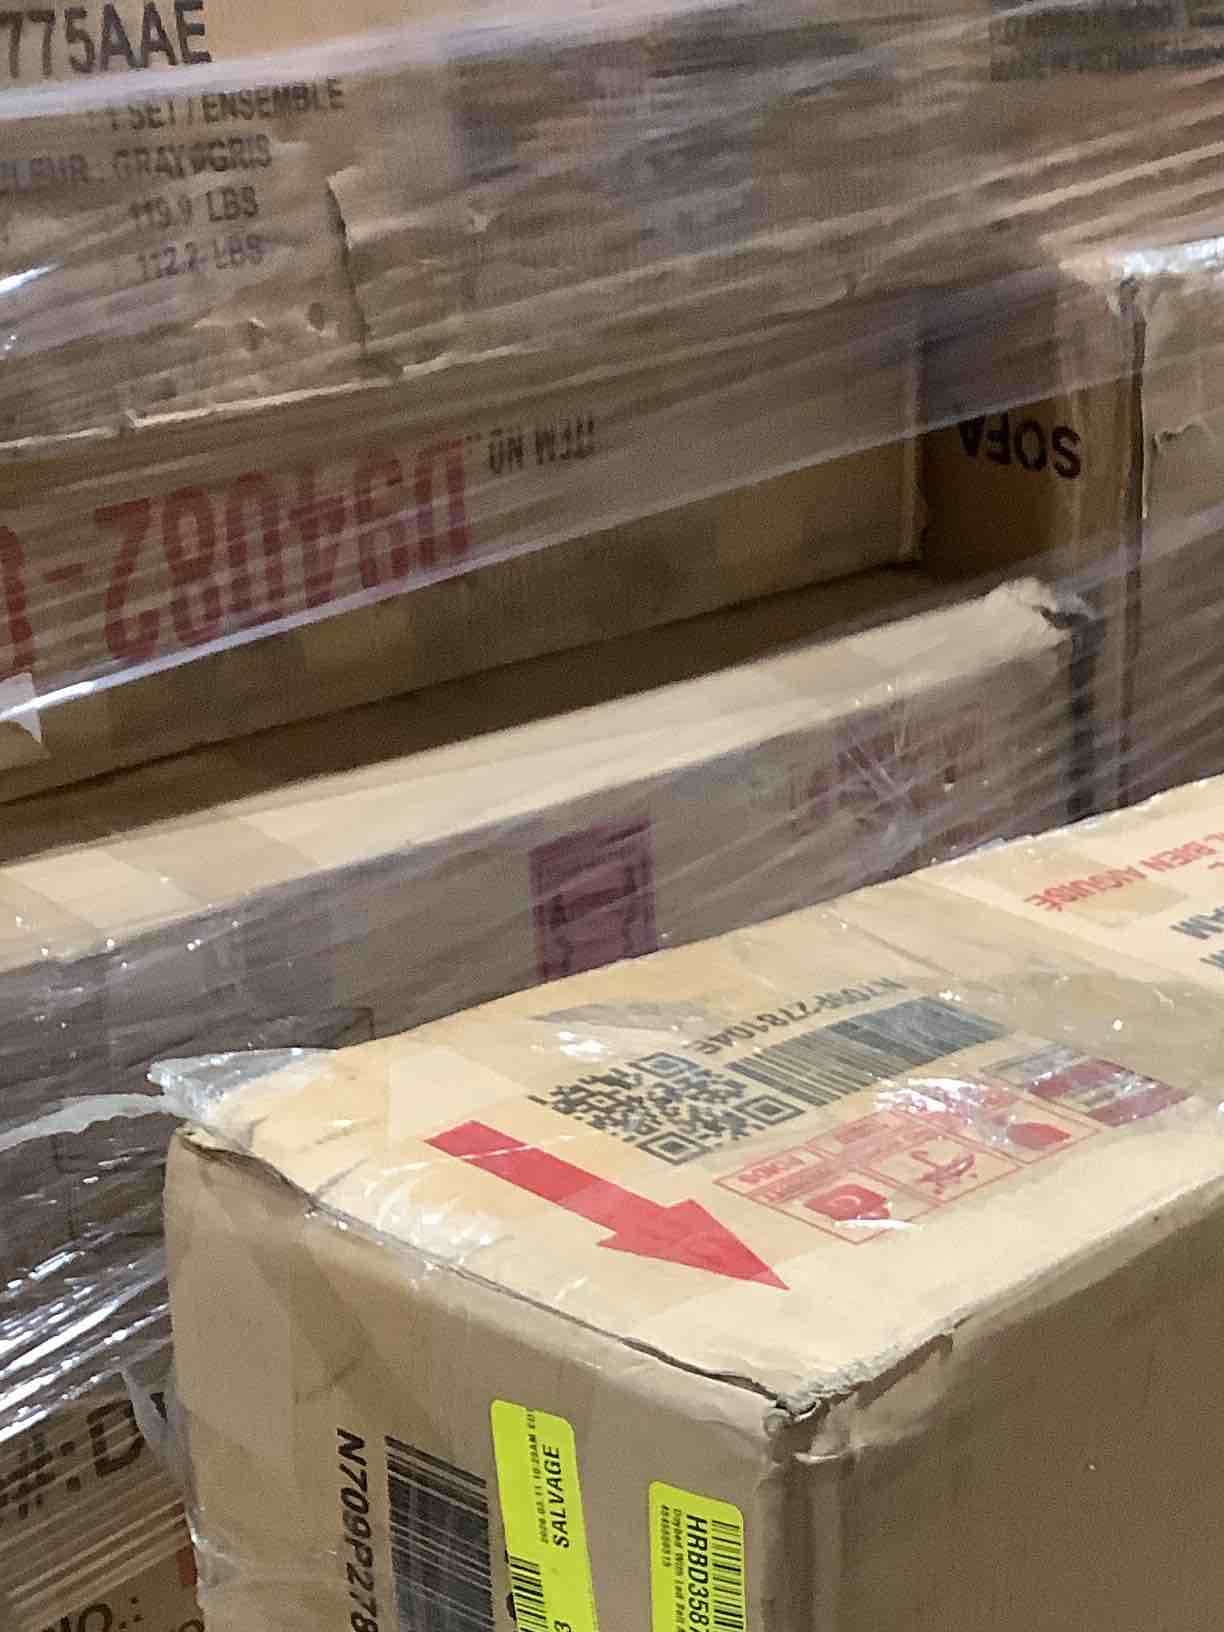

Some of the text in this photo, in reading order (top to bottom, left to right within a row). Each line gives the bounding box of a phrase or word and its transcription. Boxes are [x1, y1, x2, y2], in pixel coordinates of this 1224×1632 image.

[956, 417, 1083, 479] SOFA
[1141, 842, 1217, 872] BIEN
[1026, 867, 1146, 911] AIGUISÉ
[541, 1444, 571, 1549] SALVAGE
